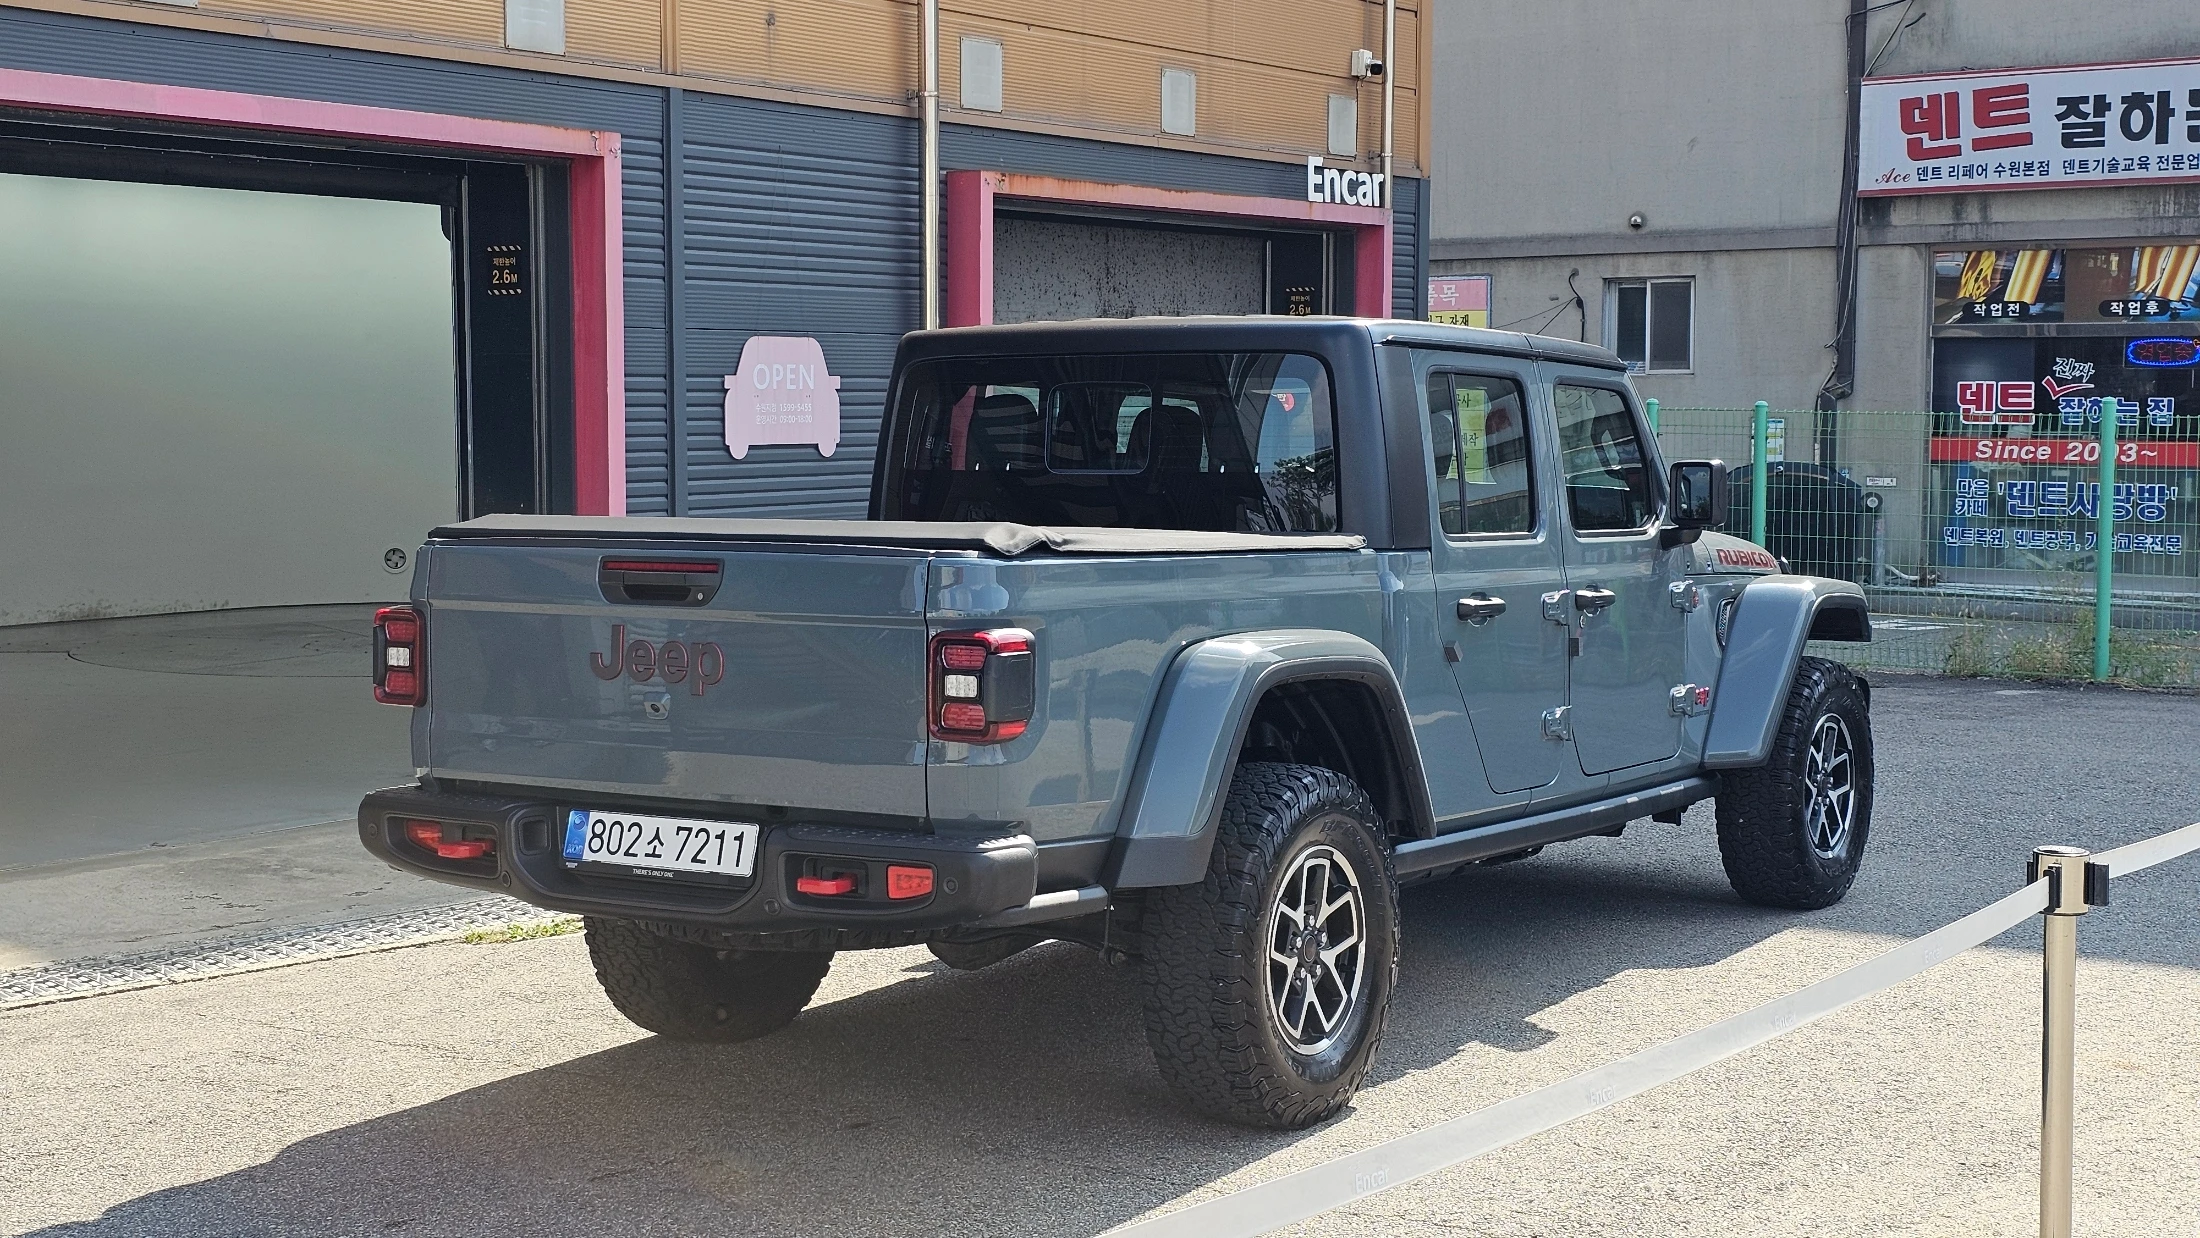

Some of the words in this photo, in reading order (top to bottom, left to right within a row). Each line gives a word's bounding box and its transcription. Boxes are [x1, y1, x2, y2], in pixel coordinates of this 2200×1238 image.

[1899, 83, 2034, 162] 덴트
[2054, 88, 2200, 149] 잘하
[1307, 155, 1385, 207] Encar
[1875, 167, 1912, 185] Ace
[1916, 165, 1943, 182] 덴트
[1948, 162, 1989, 181] 리페어
[1993, 159, 2051, 178] 수원본점
[2062, 155, 2151, 176] 덴트기술교육
[492, 269, 518, 284] 2.6M
[1973, 303, 2021, 317] 작업전
[2109, 300, 2160, 316] 작업후
[753, 363, 815, 390] OPEN
[2052, 357, 2096, 383] 진짜
[1957, 381, 2035, 425] 덴트
[2146, 397, 2175, 426] 집
[1975, 440, 2051, 460] Since
[2063, 442, 2158, 463] 203~
[1954, 497, 1988, 517] 카페
[1716, 548, 1777, 568] RUBICON
[589, 624, 725, 697] Jeep
[587, 818, 665, 858] 802소
[674, 825, 745, 868] 7211
[1355, 1167, 1390, 1193] Encar
